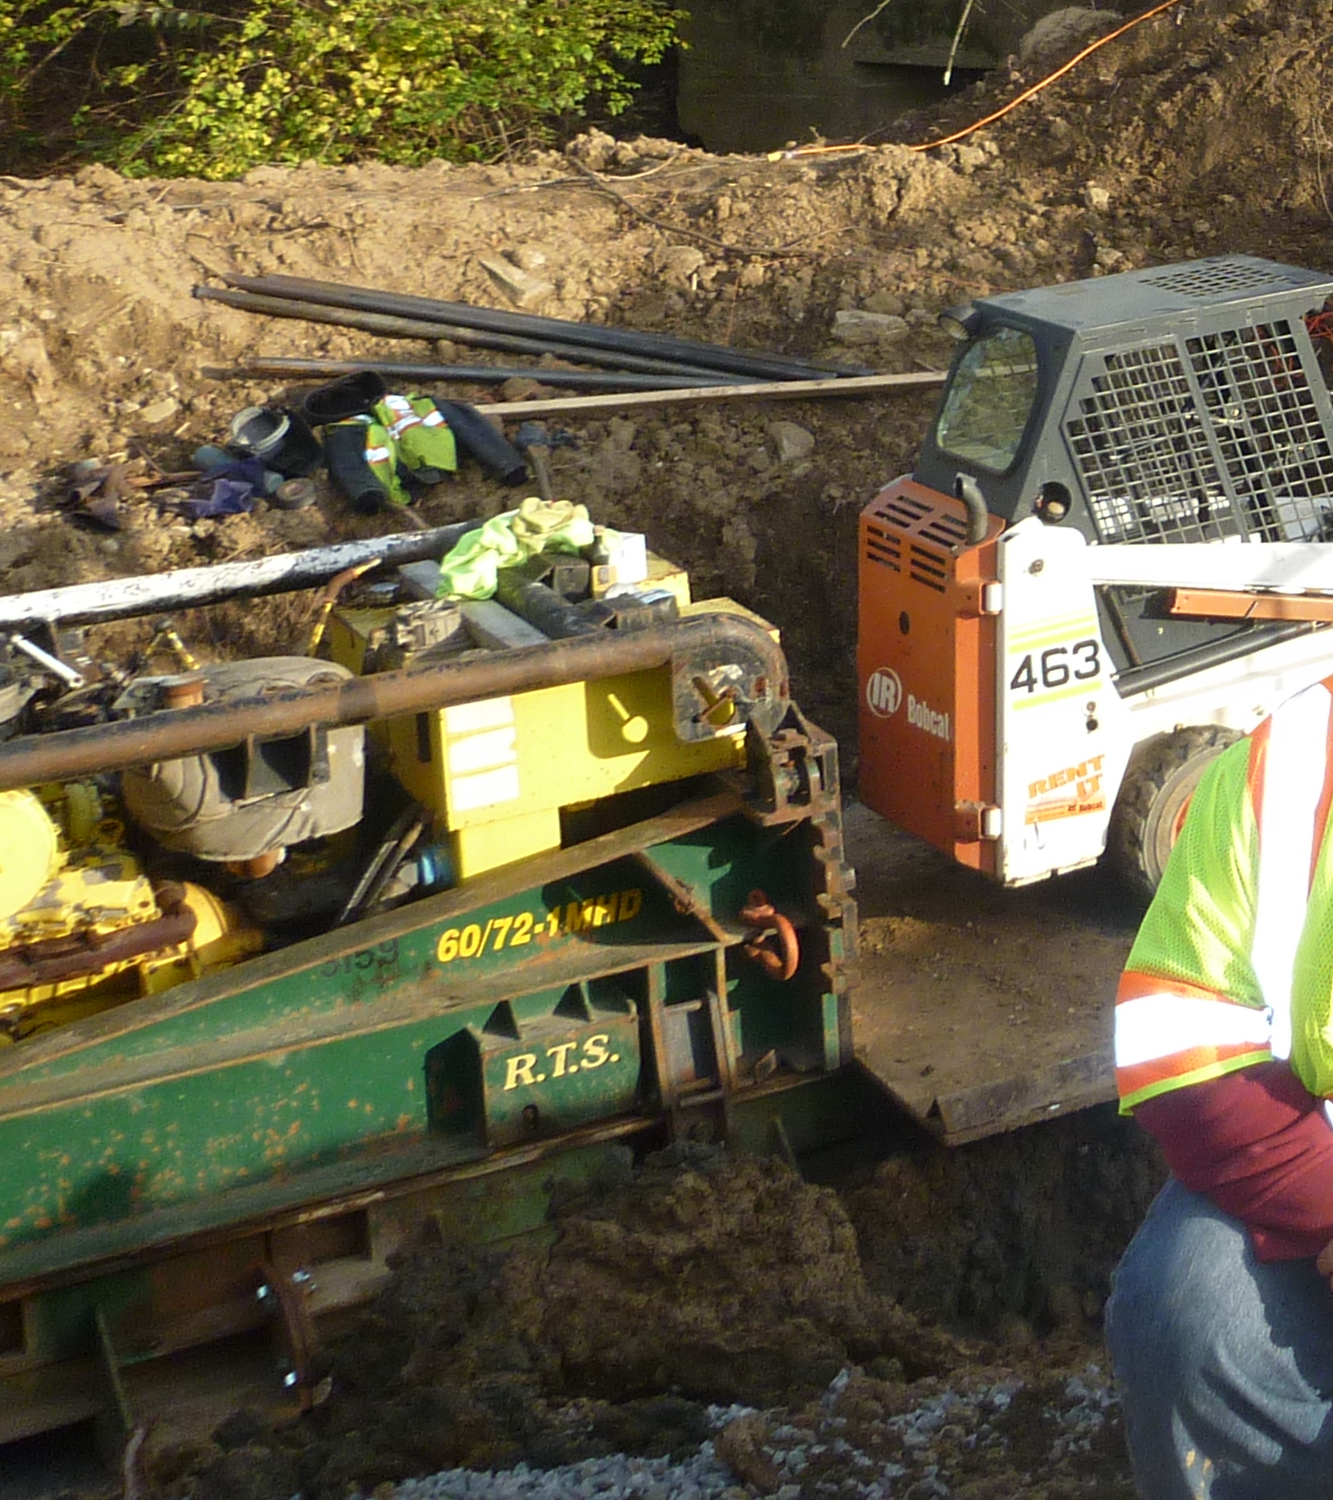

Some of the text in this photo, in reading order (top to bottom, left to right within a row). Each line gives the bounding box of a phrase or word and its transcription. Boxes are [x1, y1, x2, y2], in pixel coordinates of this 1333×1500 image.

[1010, 639, 1101, 693] 463
[907, 694, 950, 742] Bobcat
[1028, 754, 1105, 799] RENT
[1076, 773, 1103, 798] IT
[503, 1034, 620, 1091] R.T.S.
